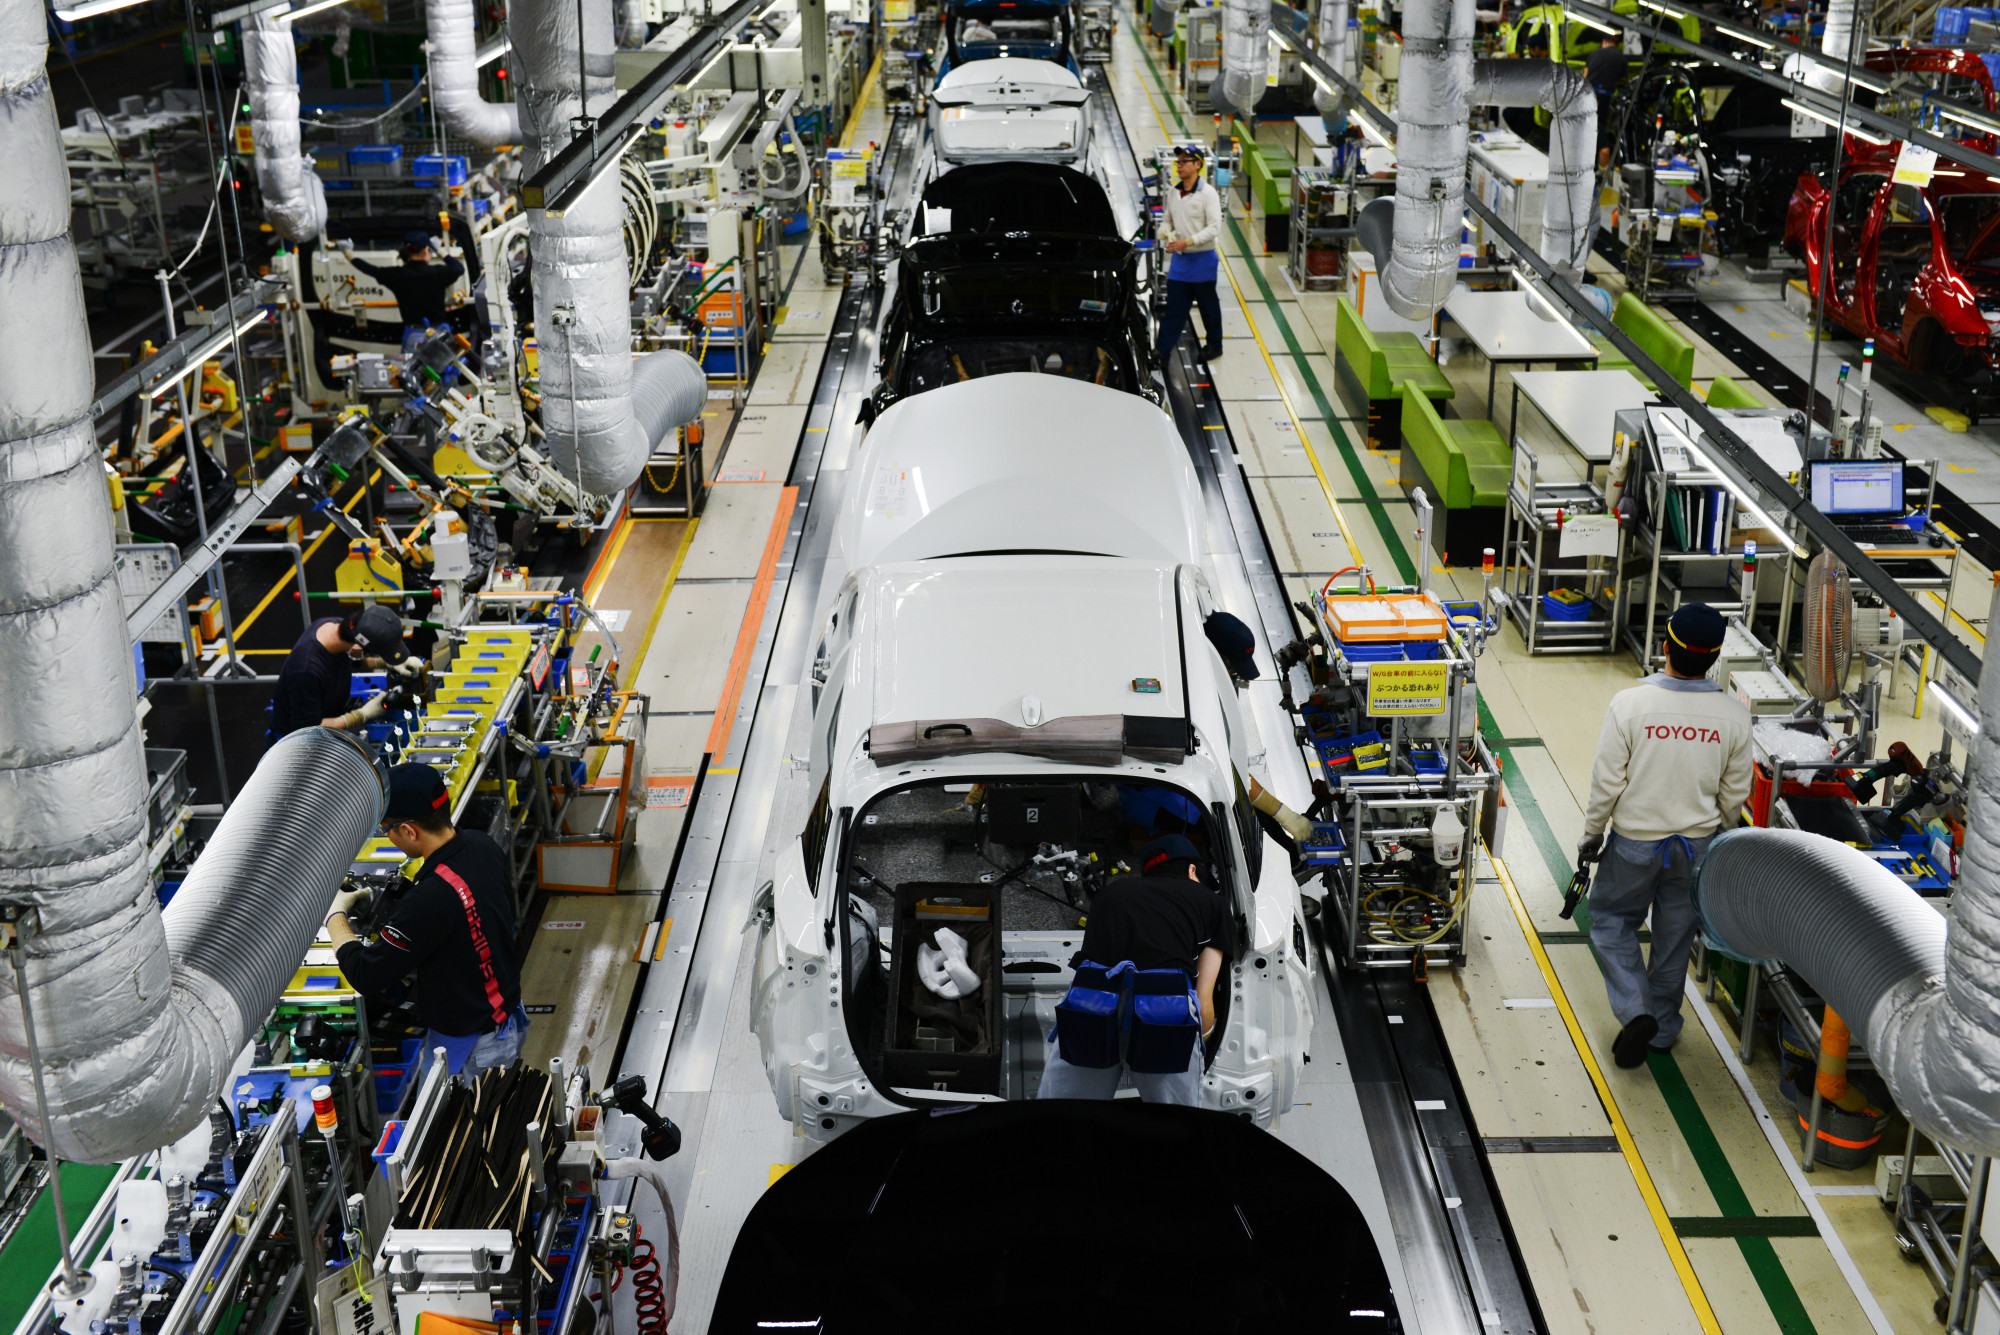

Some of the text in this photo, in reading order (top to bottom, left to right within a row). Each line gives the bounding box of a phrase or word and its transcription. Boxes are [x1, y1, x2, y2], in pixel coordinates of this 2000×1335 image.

[1376, 683, 1440, 692] ぶつかる恐れあり
[1645, 725, 1721, 744] TOYOTA
[1029, 810, 1037, 820] 2
